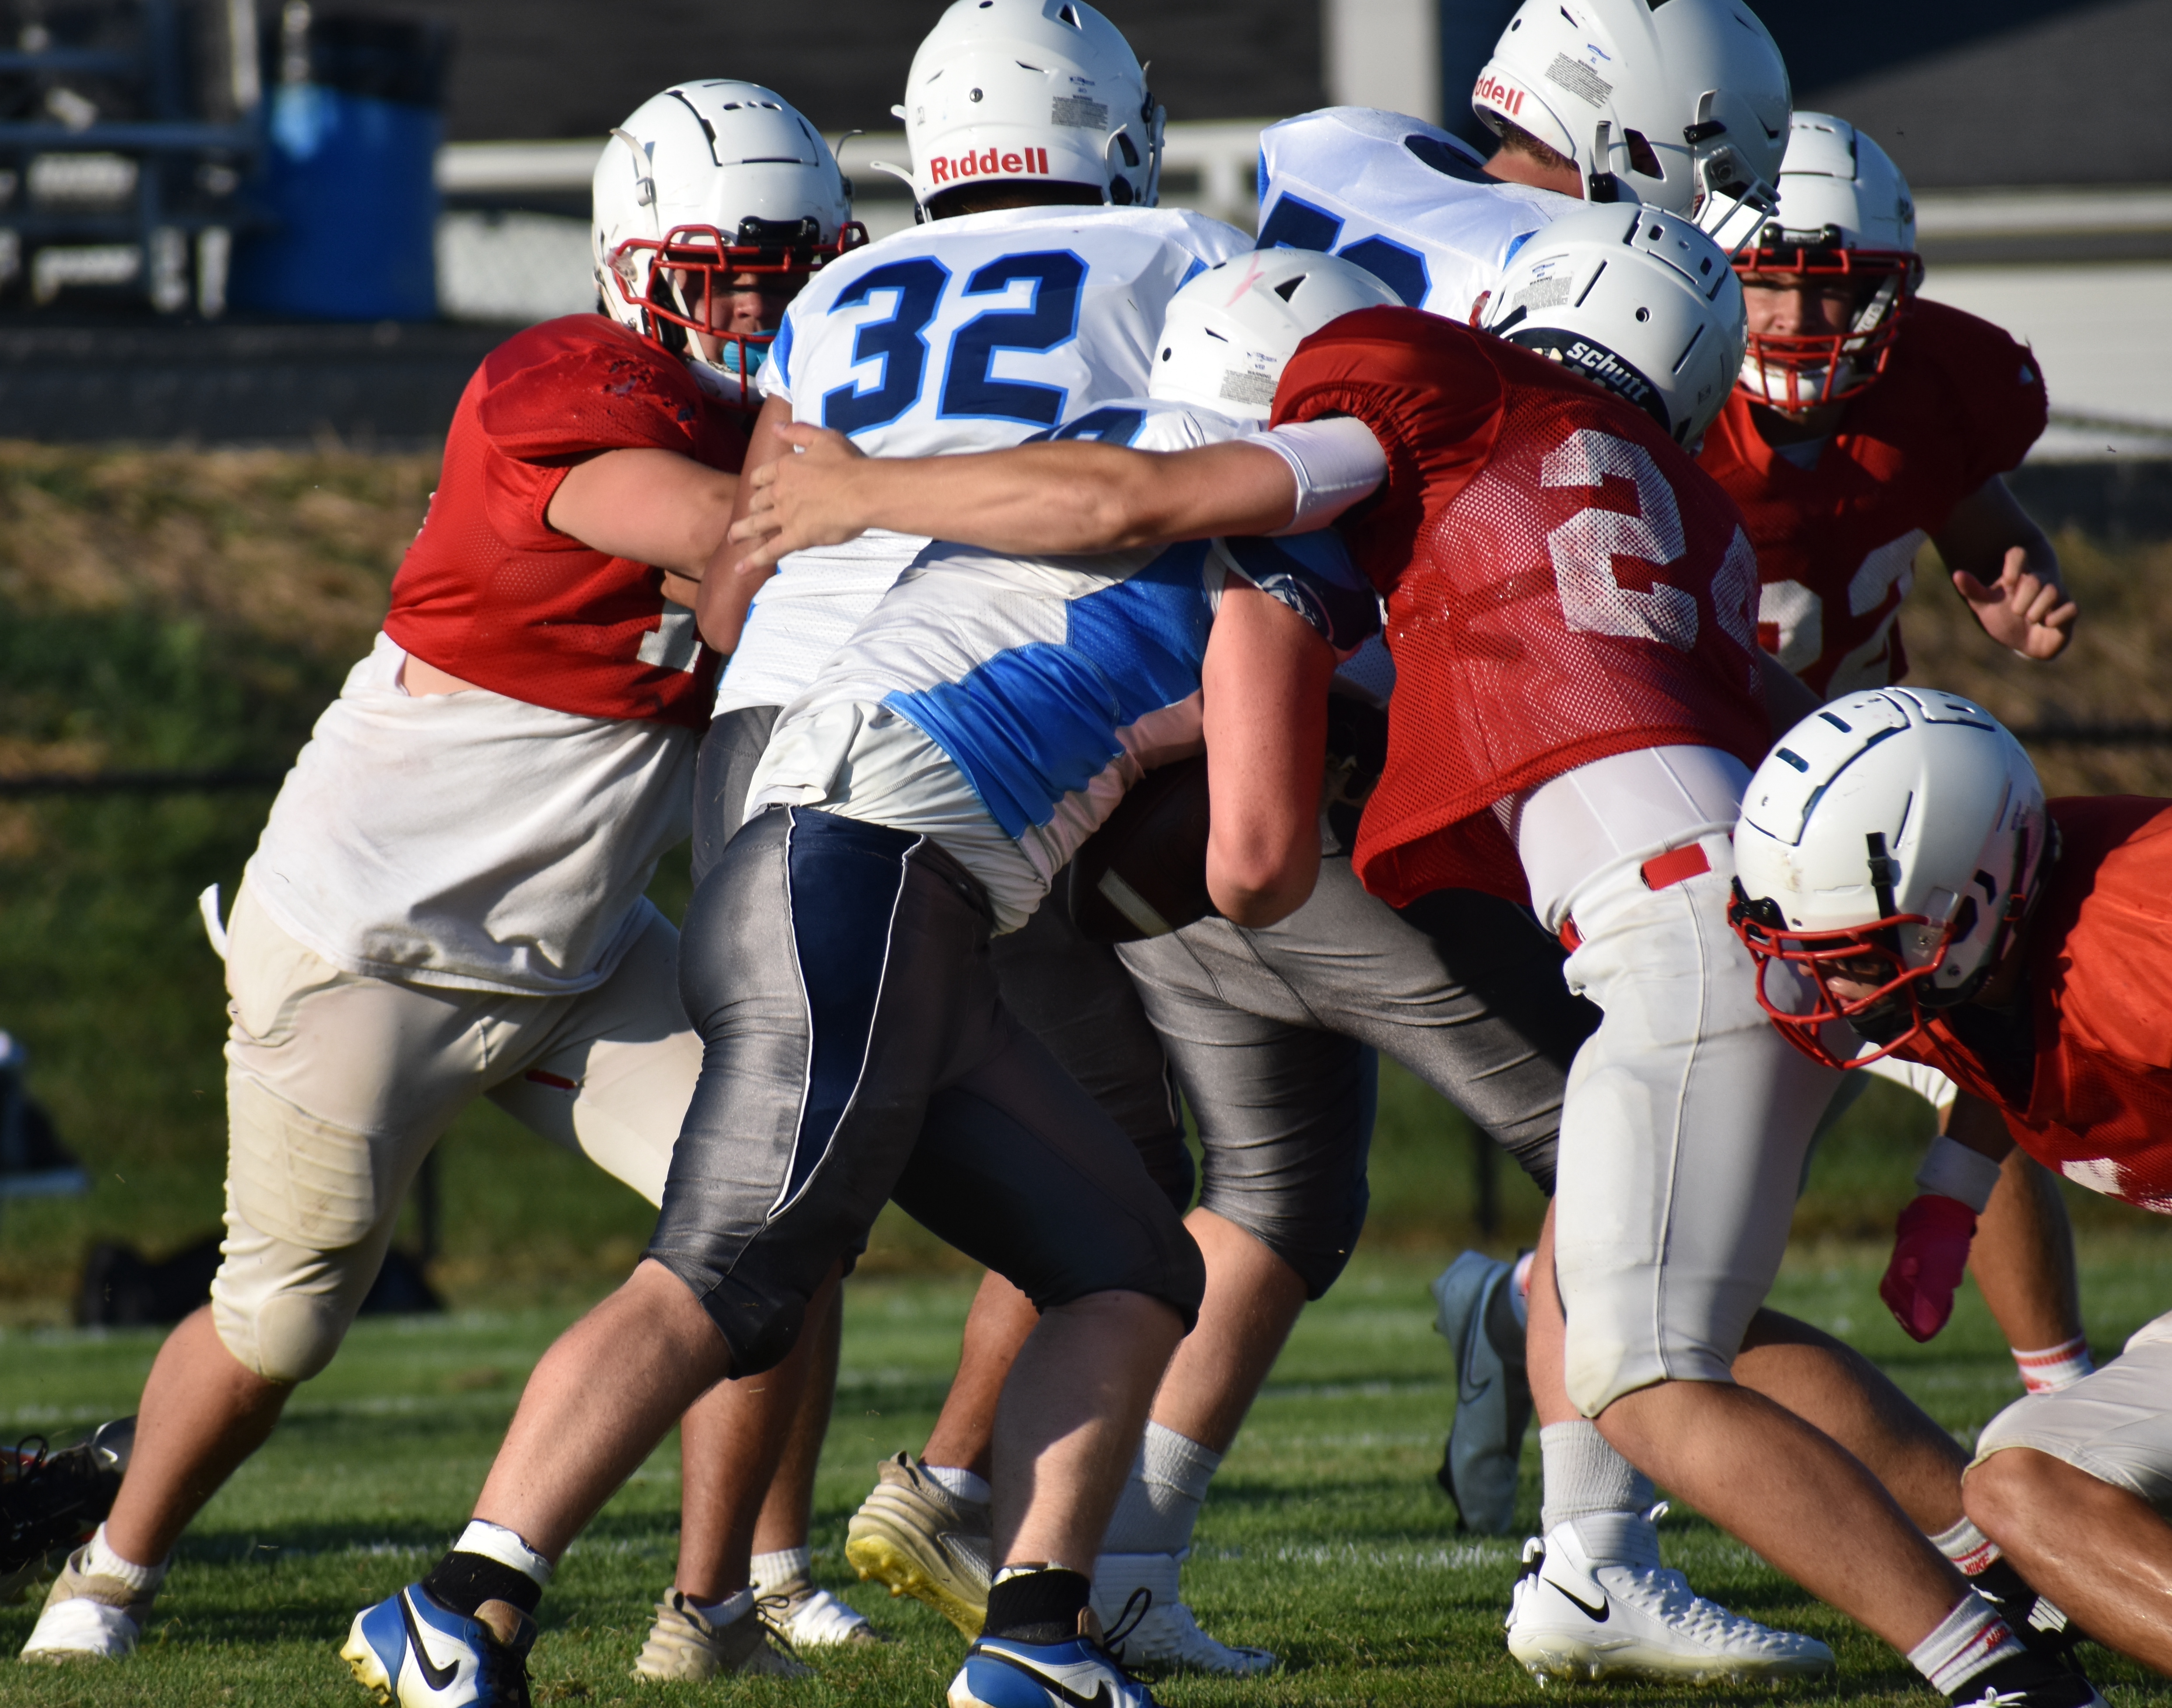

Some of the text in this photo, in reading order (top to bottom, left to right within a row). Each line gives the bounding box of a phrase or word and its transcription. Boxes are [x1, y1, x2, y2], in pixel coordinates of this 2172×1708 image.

[1475, 74, 1525, 116] ddell
[930, 147, 1049, 184] Riddell
[822, 248, 1090, 438] 32
[1566, 342, 1650, 401] schutt
[1965, 1553, 1990, 1575] NIKE
